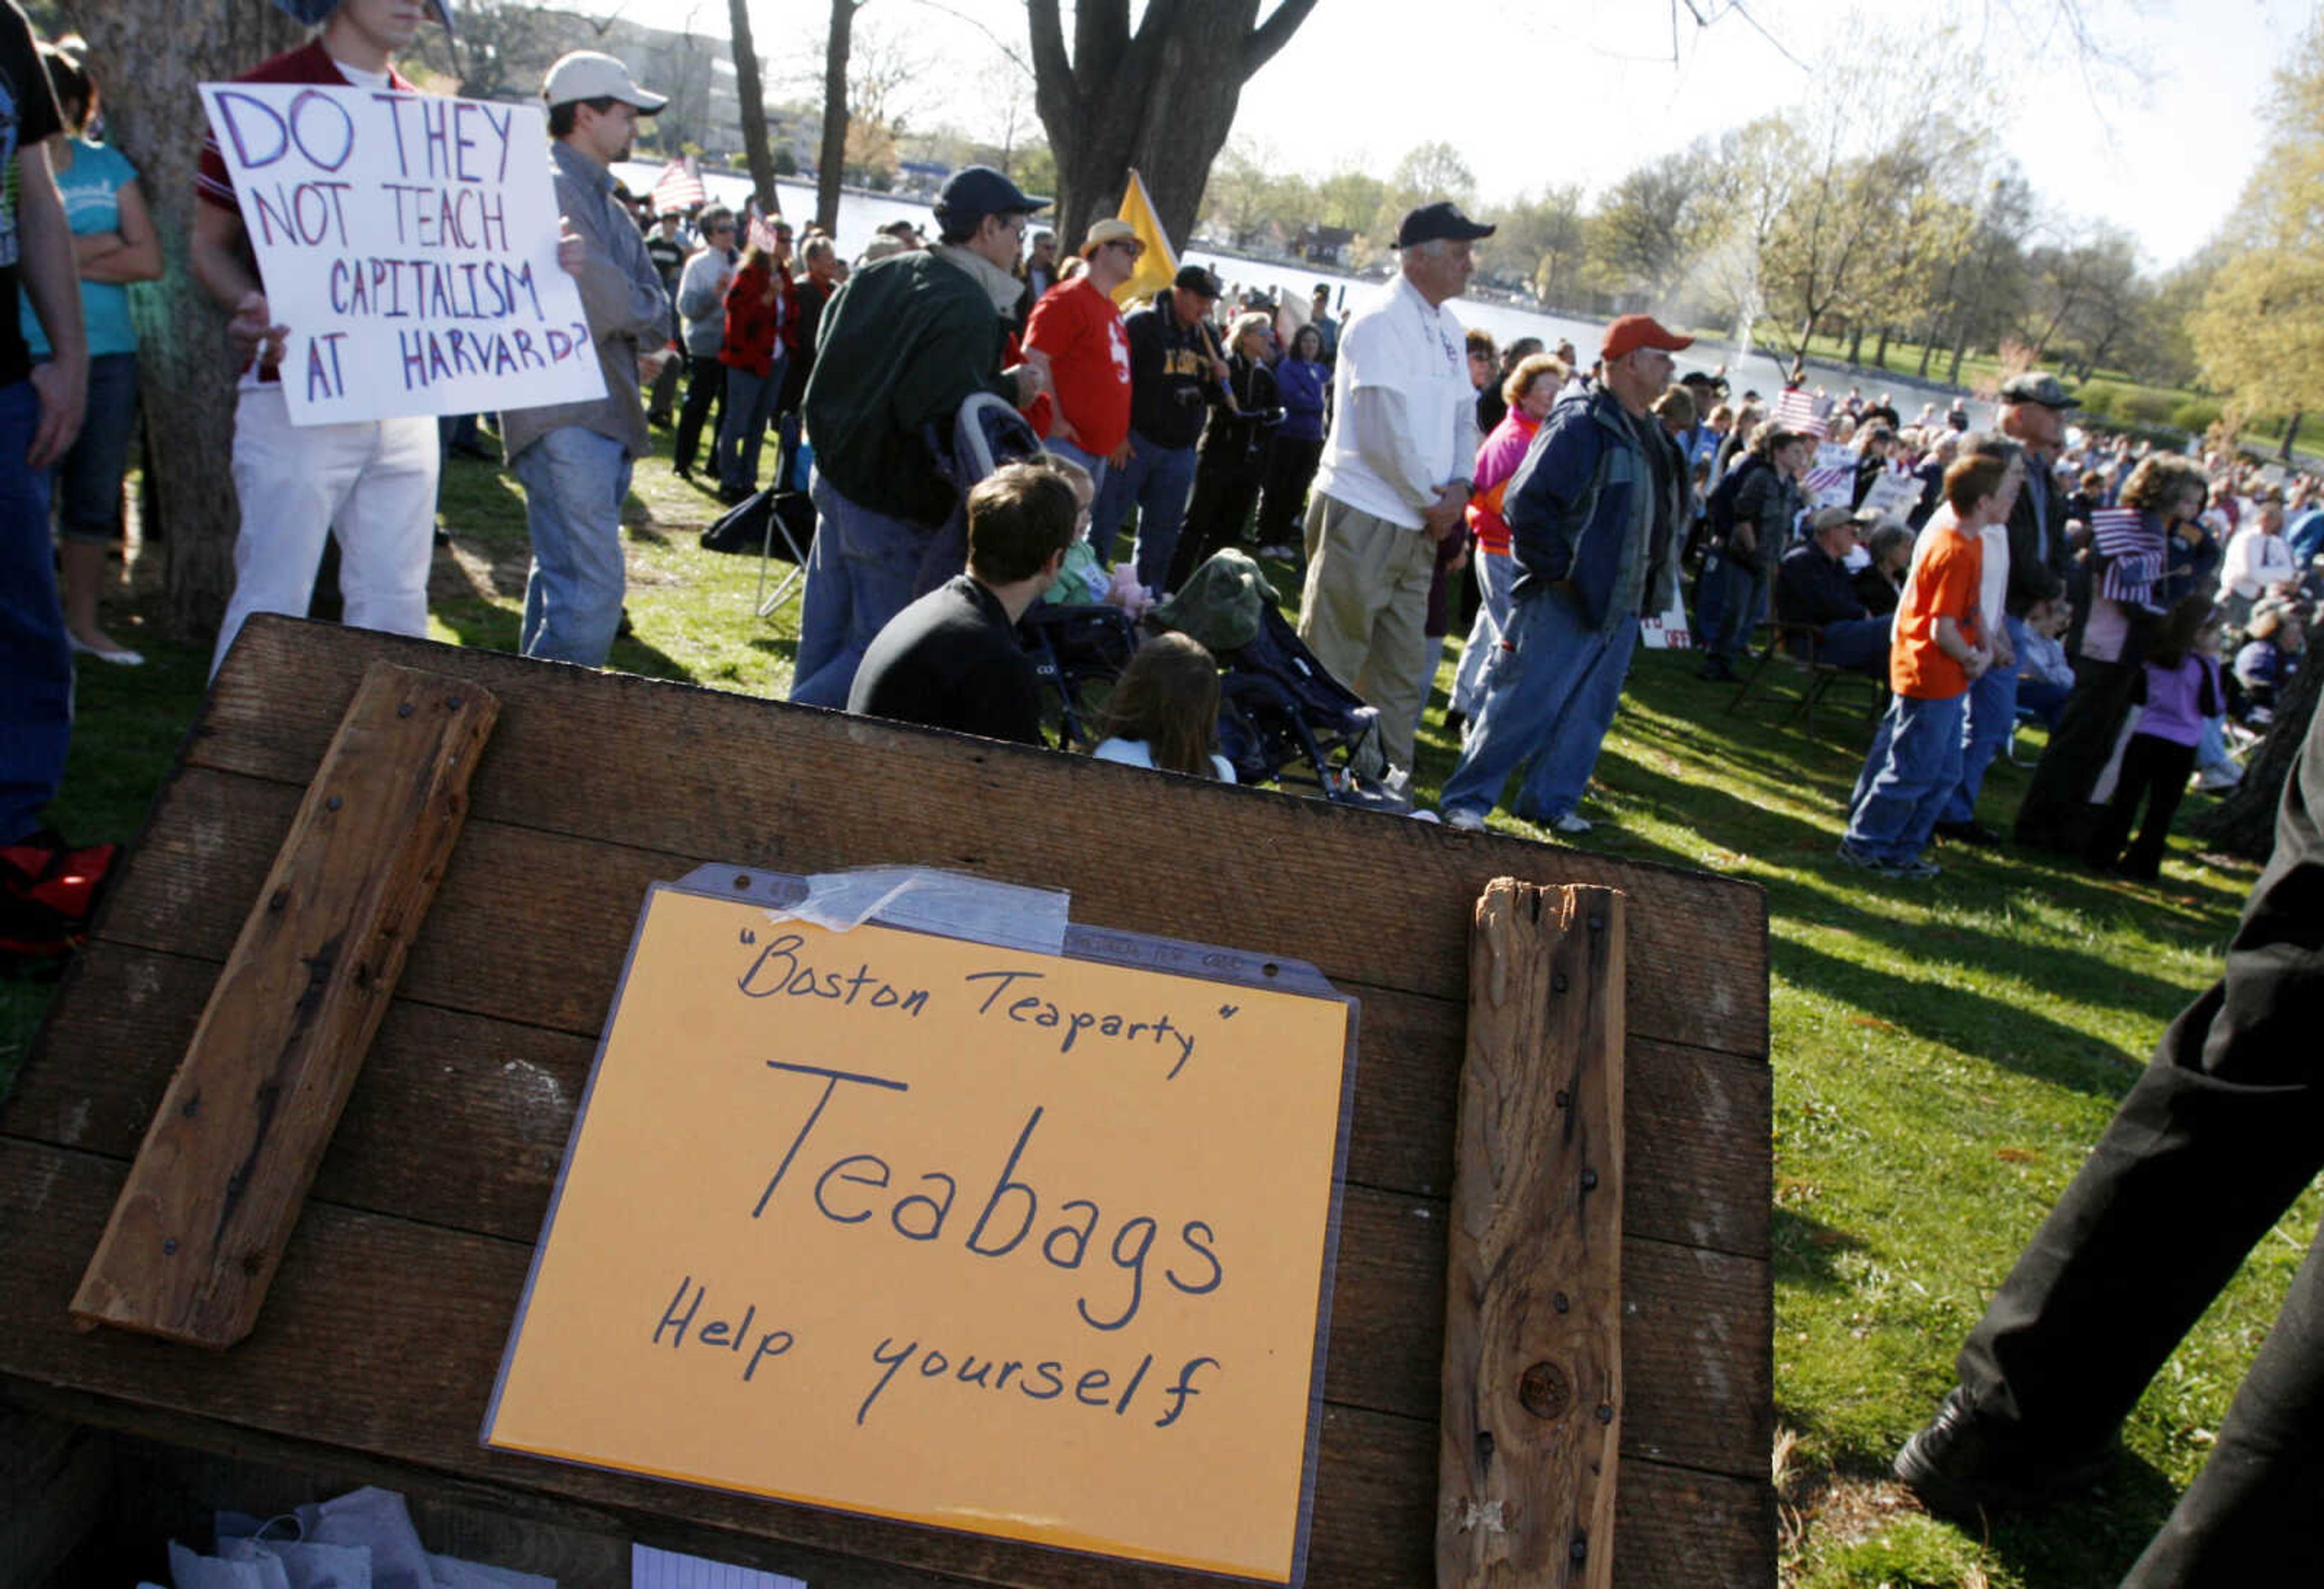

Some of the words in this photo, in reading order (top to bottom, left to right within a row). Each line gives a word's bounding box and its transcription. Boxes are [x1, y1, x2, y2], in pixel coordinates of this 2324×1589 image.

[214, 90, 354, 172] DO
[371, 93, 512, 183] THEY
[251, 182, 352, 246] NOT
[381, 183, 508, 251] TEACH
[330, 257, 545, 321] CAPITALISM
[308, 332, 349, 402] AT
[399, 323, 589, 390] HARVARD?
[738, 929, 929, 1017] "Boston
[752, 1060, 1222, 1331] Teabags
[653, 1277, 793, 1381] Help
[857, 1337, 1221, 1427] yourself
